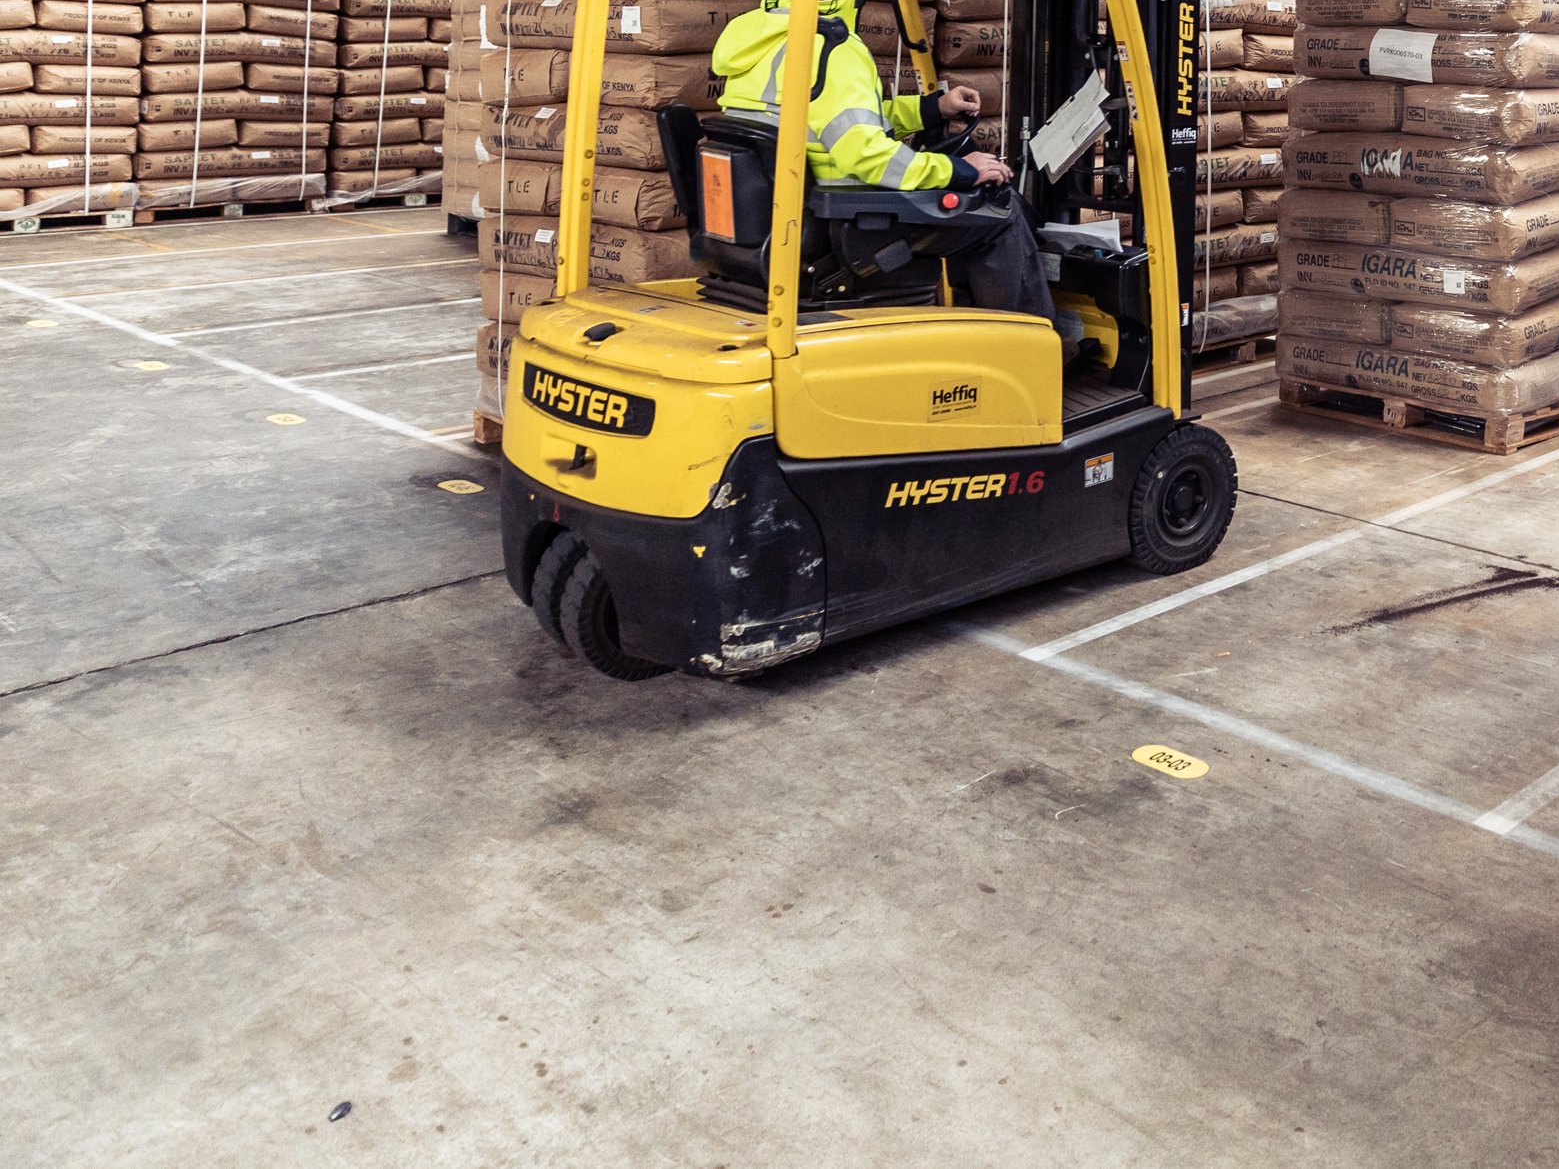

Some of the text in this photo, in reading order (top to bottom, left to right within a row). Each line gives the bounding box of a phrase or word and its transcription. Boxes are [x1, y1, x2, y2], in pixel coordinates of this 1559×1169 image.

[1307, 39, 1339, 50] GRADE
[1177, 2, 1194, 116] HYSTER
[1296, 151, 1328, 164] GRADE
[1526, 214, 1549, 232] GRADE
[1297, 254, 1417, 278] GRADE IGARA
[1293, 347, 1409, 377] GRADE IGARA
[532, 370, 628, 428] HYSTER
[885, 471, 1045, 508] HYSTER 1.6
[1149, 752, 1191, 771] 03-03
